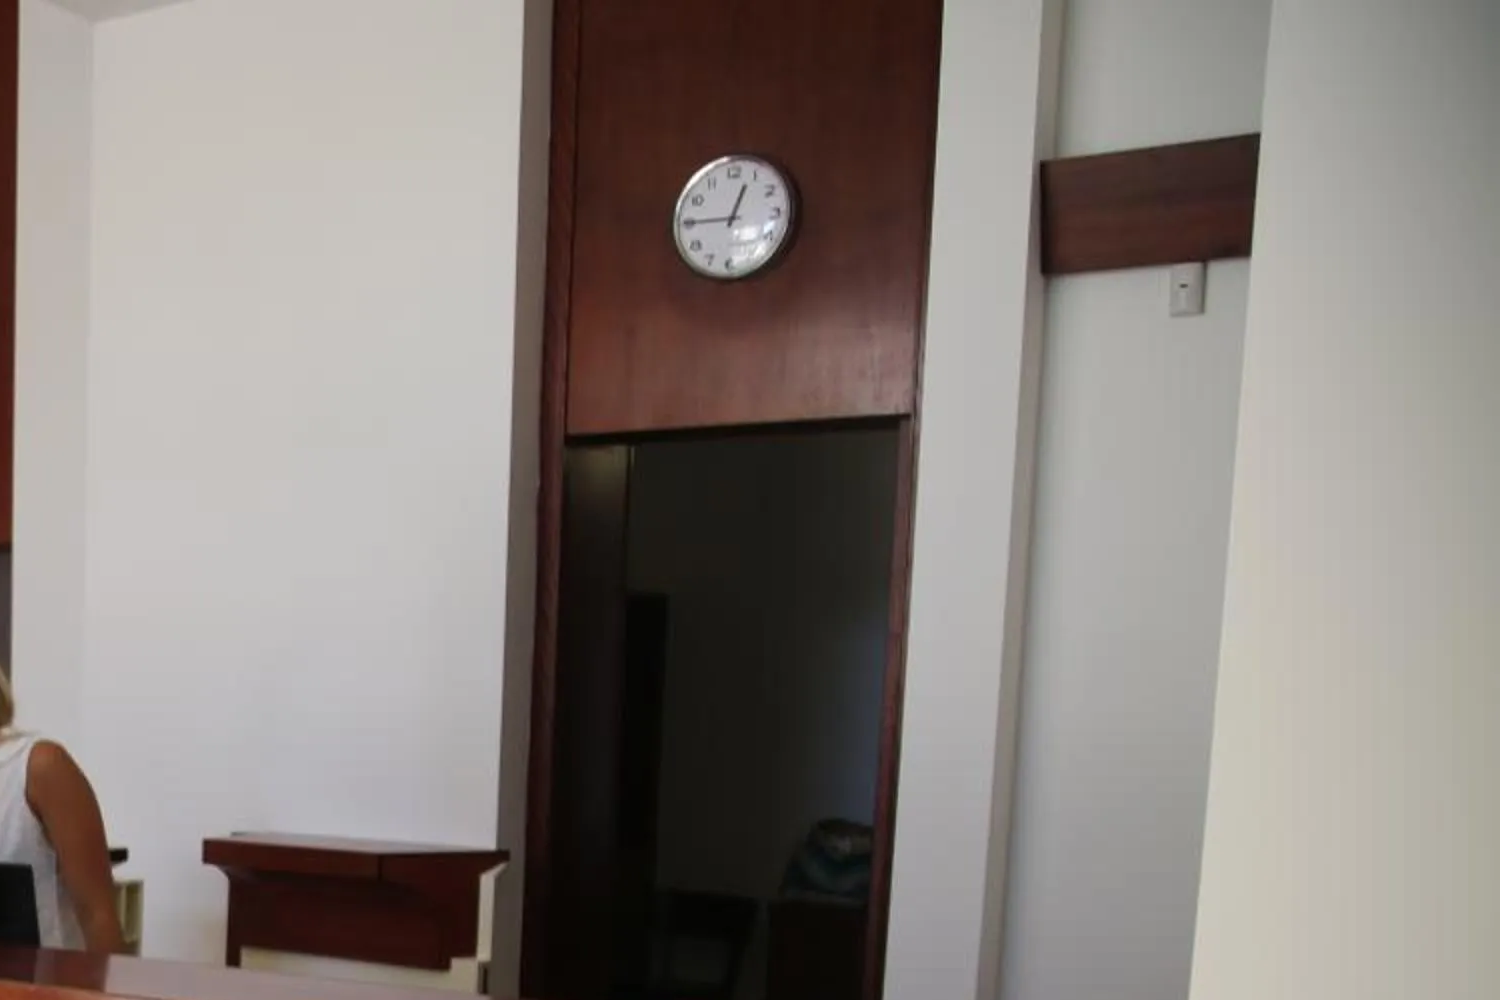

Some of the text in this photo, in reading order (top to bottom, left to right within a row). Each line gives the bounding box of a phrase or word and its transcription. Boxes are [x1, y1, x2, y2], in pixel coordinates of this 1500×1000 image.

[727, 165, 742, 179] 12
[753, 169, 758, 181] 1
[707, 177, 717, 190] 11
[764, 184, 776, 197] 2
[691, 194, 705, 206] 10
[704, 253, 715, 266] 7
